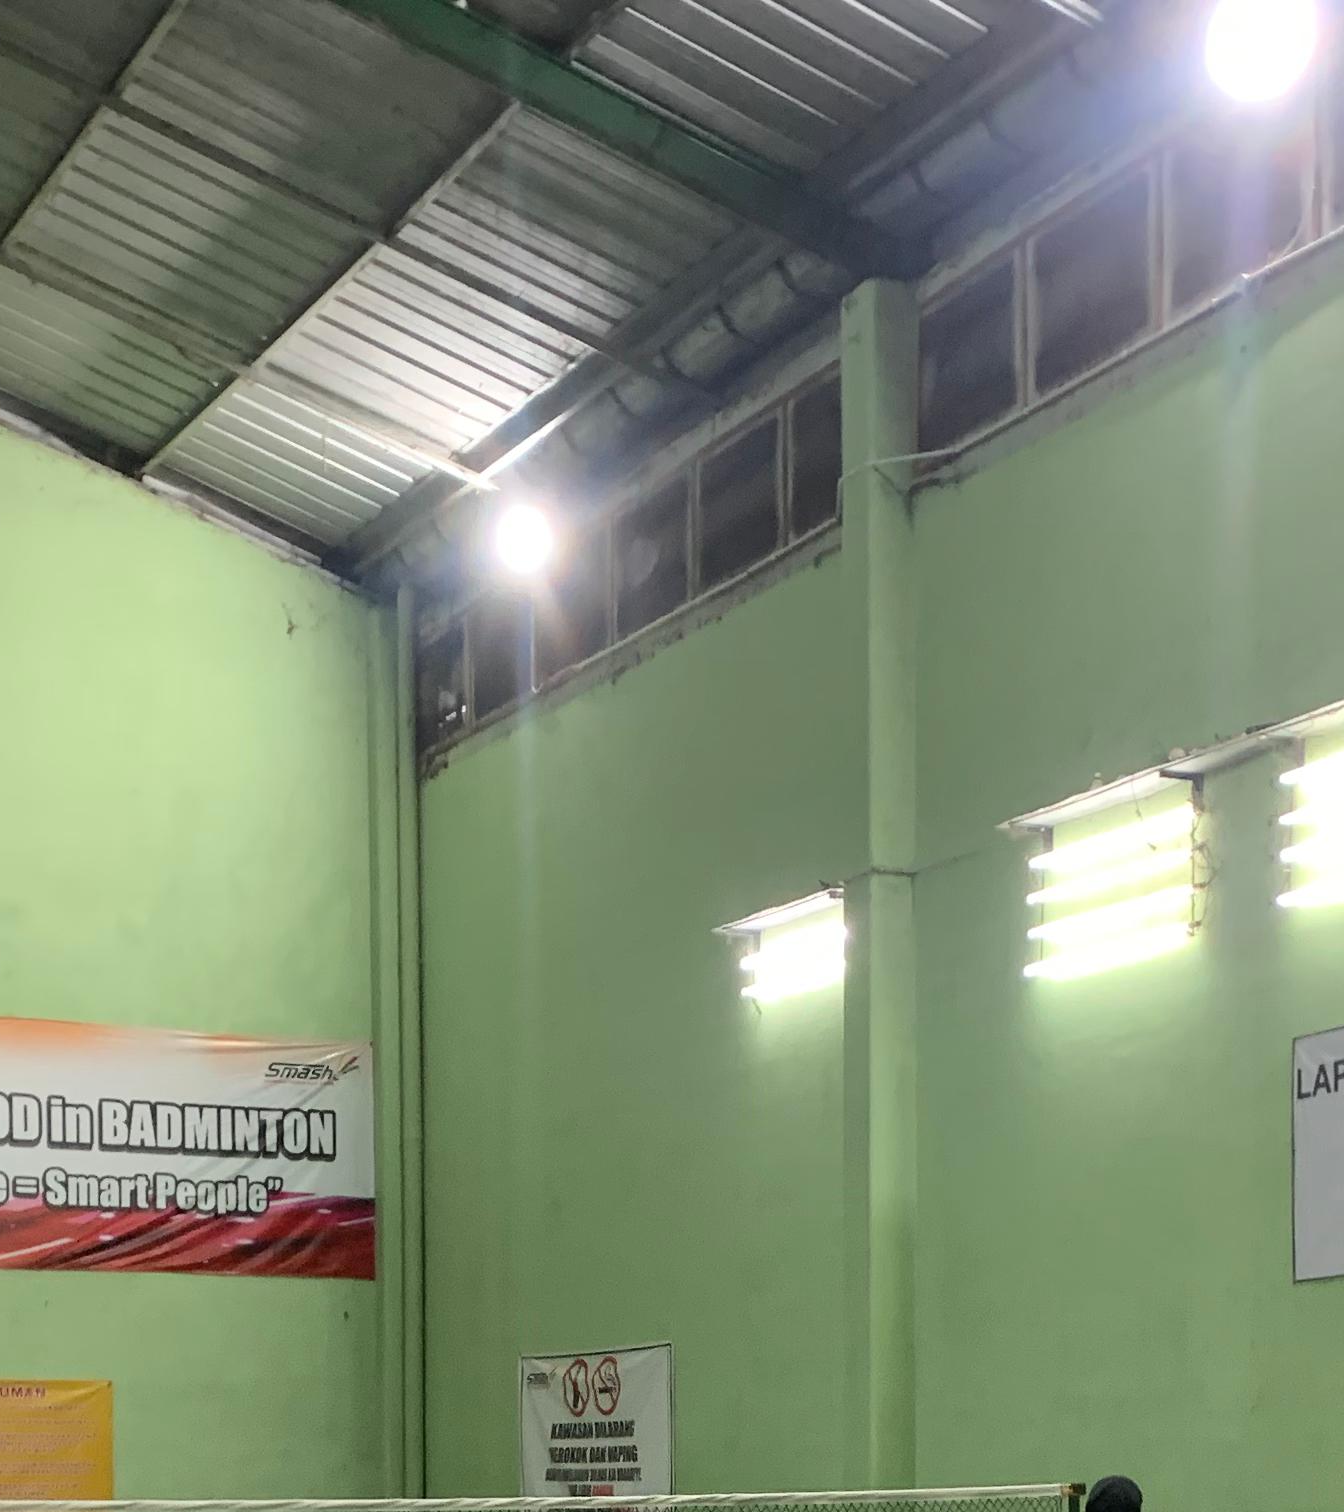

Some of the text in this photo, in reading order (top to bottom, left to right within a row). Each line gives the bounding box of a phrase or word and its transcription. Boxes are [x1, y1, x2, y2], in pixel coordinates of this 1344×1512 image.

[264, 1062, 334, 1080] Smash
[47, 1095, 94, 1151] in
[98, 1098, 337, 1162] BADMINTON
[42, 1166, 150, 1212] Smart
